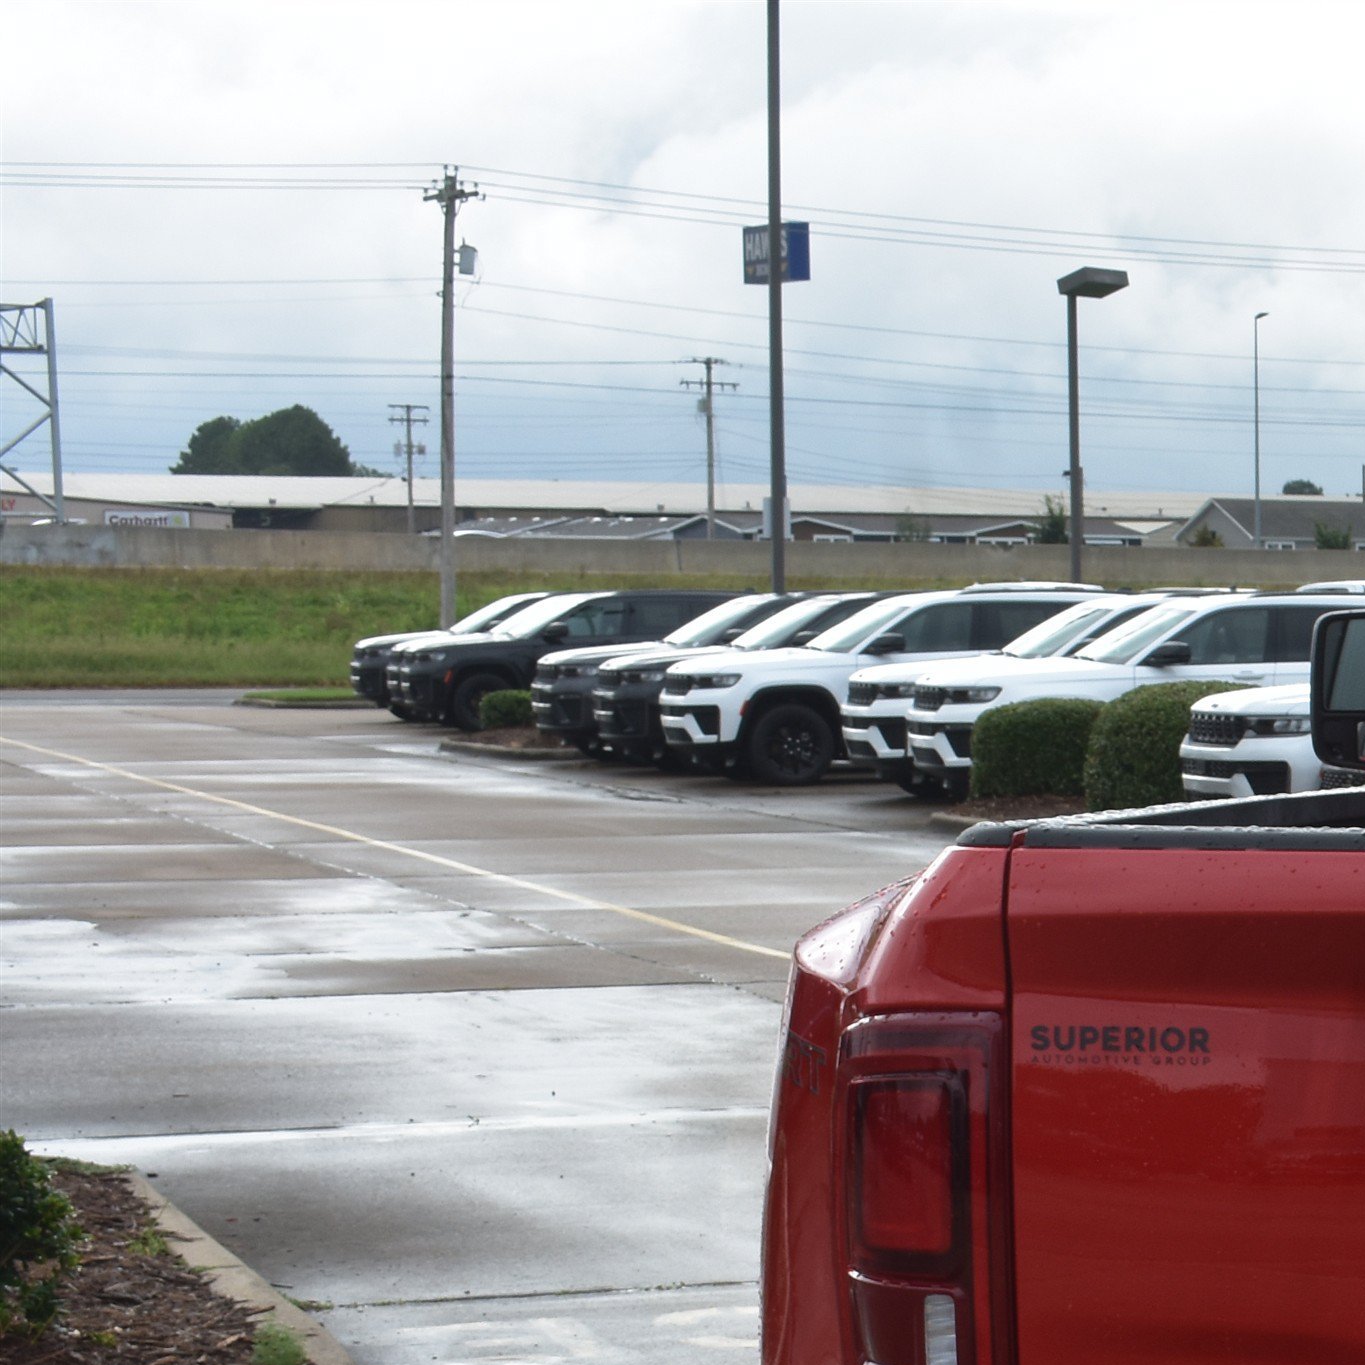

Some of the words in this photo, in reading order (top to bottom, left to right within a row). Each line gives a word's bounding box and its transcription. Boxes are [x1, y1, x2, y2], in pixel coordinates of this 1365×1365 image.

[746, 230, 788, 261] HAWS
[1030, 1024, 1210, 1053] SUPERIOR
[1031, 1055, 1142, 1065] AUTOMOTIVE
[1152, 1055, 1211, 1066] GROUP
